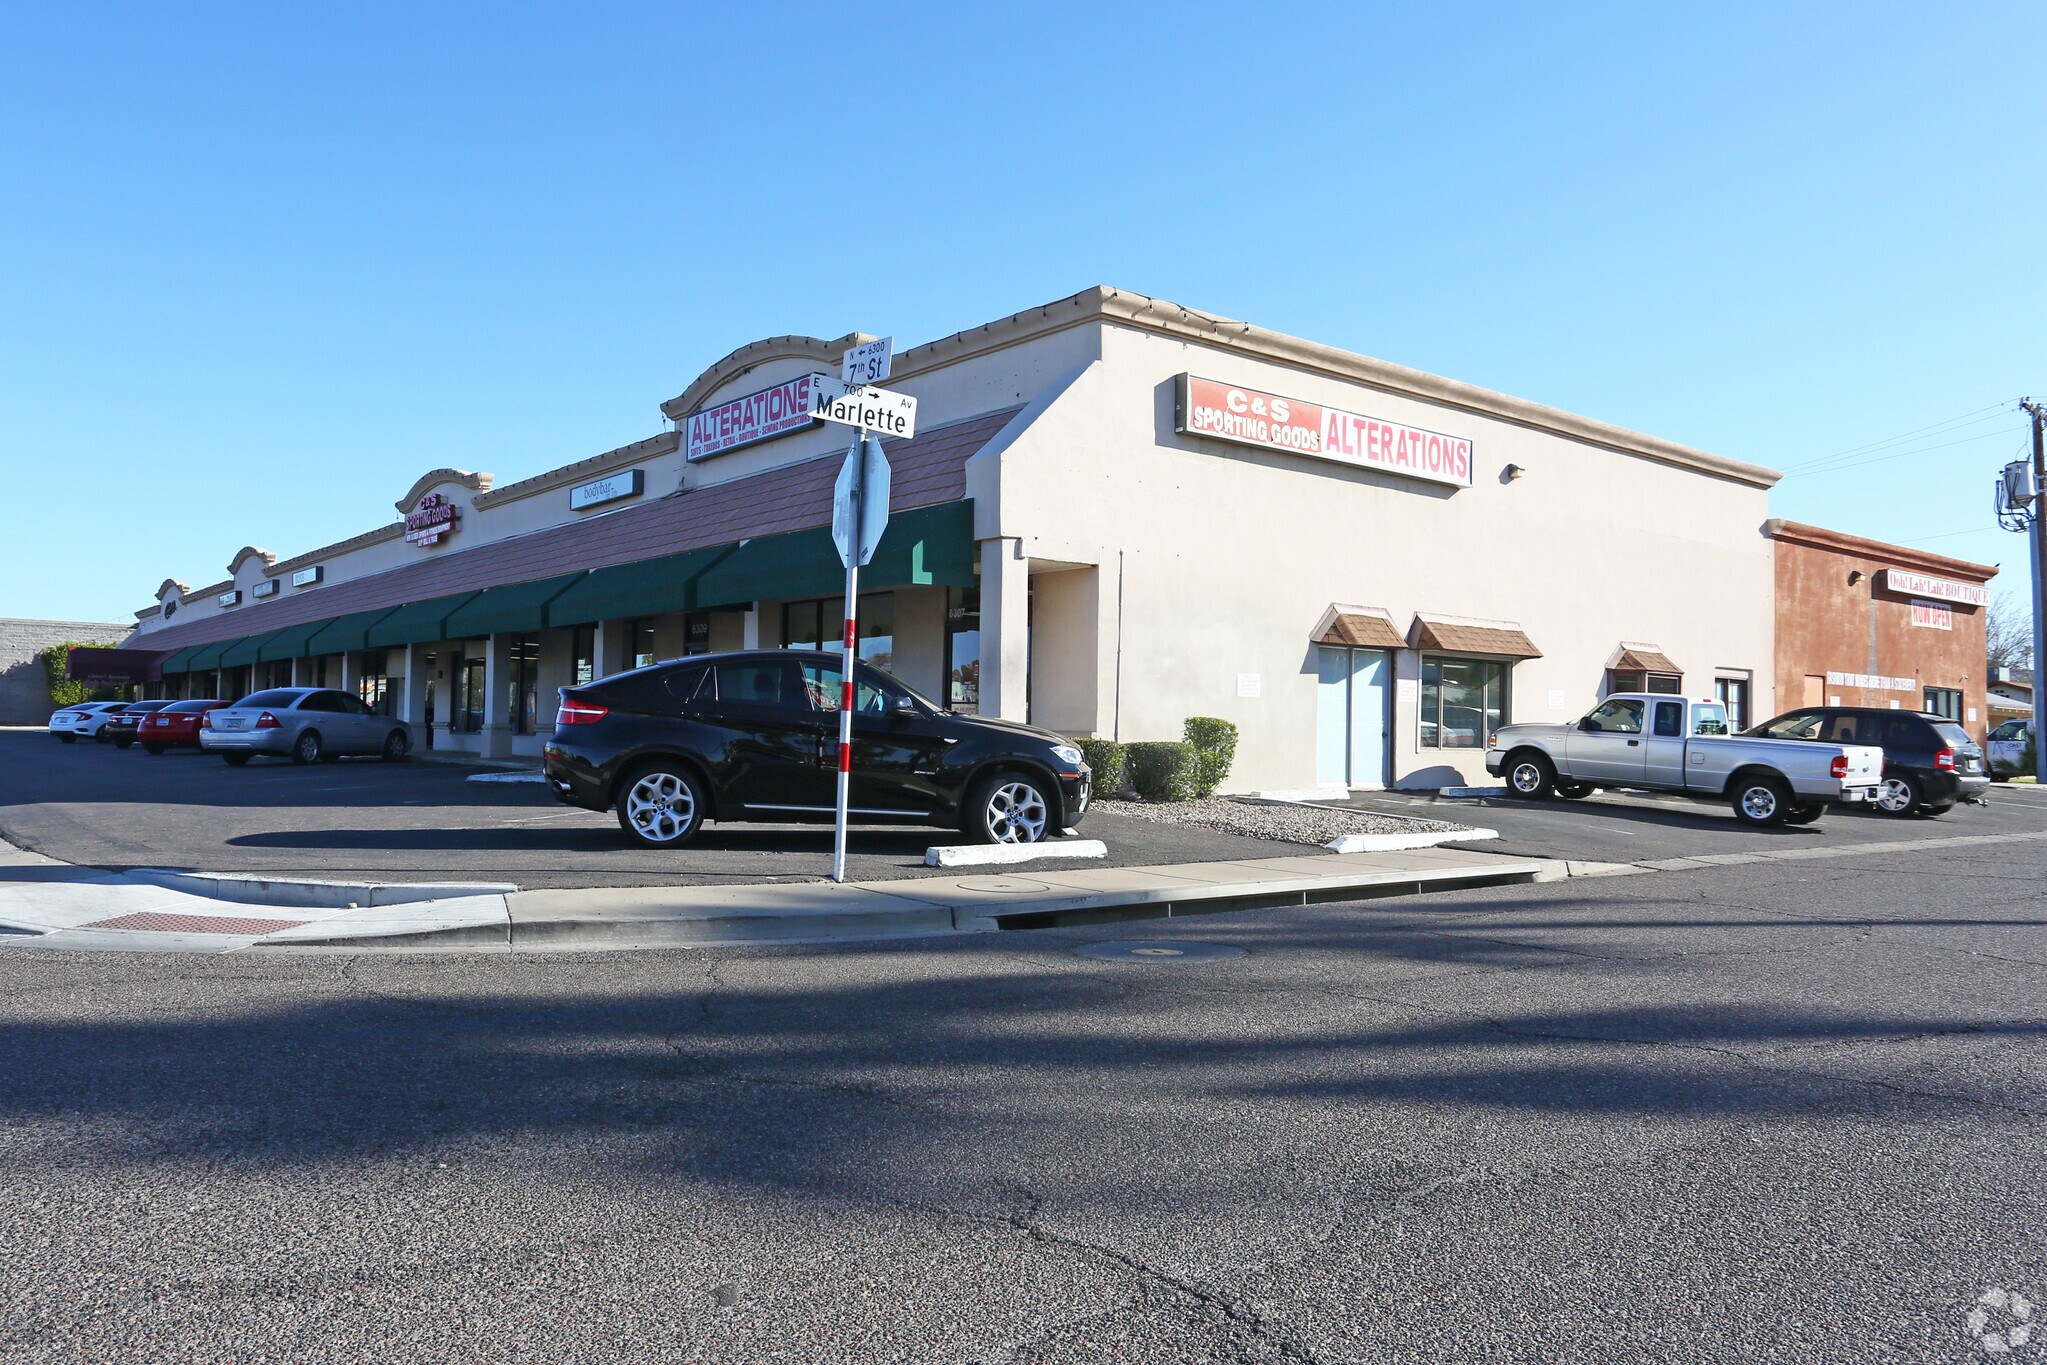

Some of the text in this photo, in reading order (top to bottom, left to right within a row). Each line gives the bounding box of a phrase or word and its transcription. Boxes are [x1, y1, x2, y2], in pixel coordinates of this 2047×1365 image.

[849, 341, 885, 361] N 6300
[849, 357, 882, 383] 7th St
[814, 377, 863, 398] E 700
[691, 378, 810, 446] ALTERATIONS
[816, 392, 905, 433] Marlette
[900, 398, 912, 409] Av
[738, 429, 759, 443] BOUTIQUE
[761, 423, 779, 436] SEWING
[1194, 405, 1320, 451] SPORTING GOODS
[1326, 413, 1468, 479] ALTERATIONS
[406, 504, 451, 531] SPORTING GOODS
[1889, 573, 1989, 604] Ooh! Lah! Lah! BOUTIQUE
[949, 607, 966, 618] 6307
[1912, 603, 1951, 627] NOW OPEN
